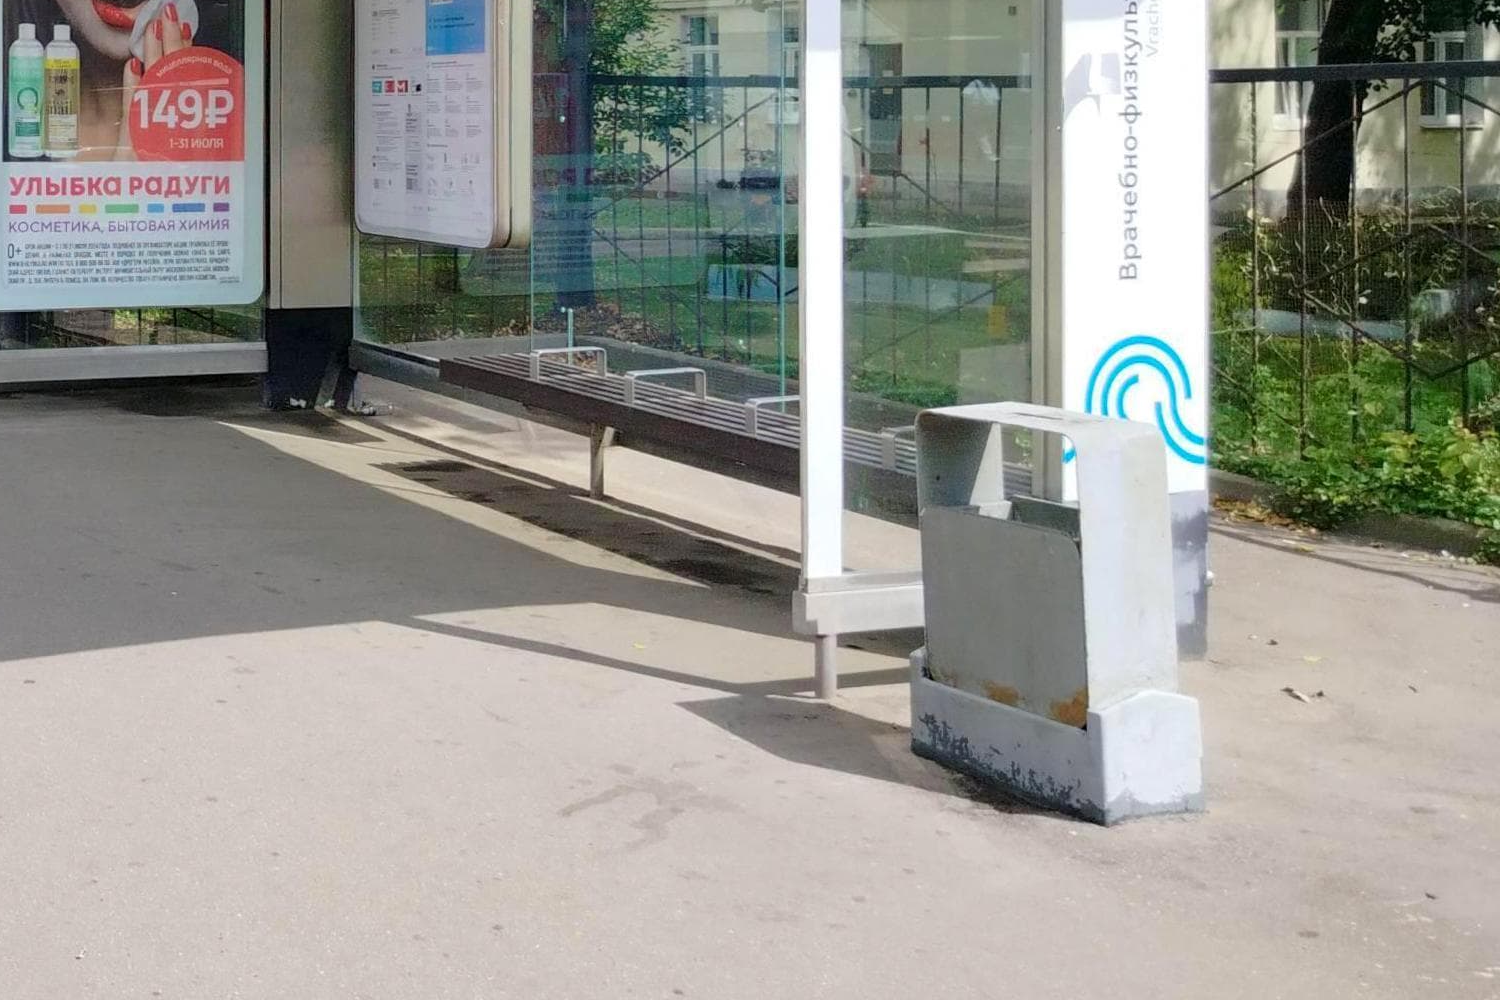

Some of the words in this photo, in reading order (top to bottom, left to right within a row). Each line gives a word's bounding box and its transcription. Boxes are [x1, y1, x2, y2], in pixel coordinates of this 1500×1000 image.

[191, 138, 224, 149] ИЮЛЯ
[8, 221, 104, 234] КОСМЕТИКА,
[108, 220, 176, 233] БЫТОВАЯ
[179, 219, 230, 232] ХИМИЯ
[7, 243, 22, 259] 0+
